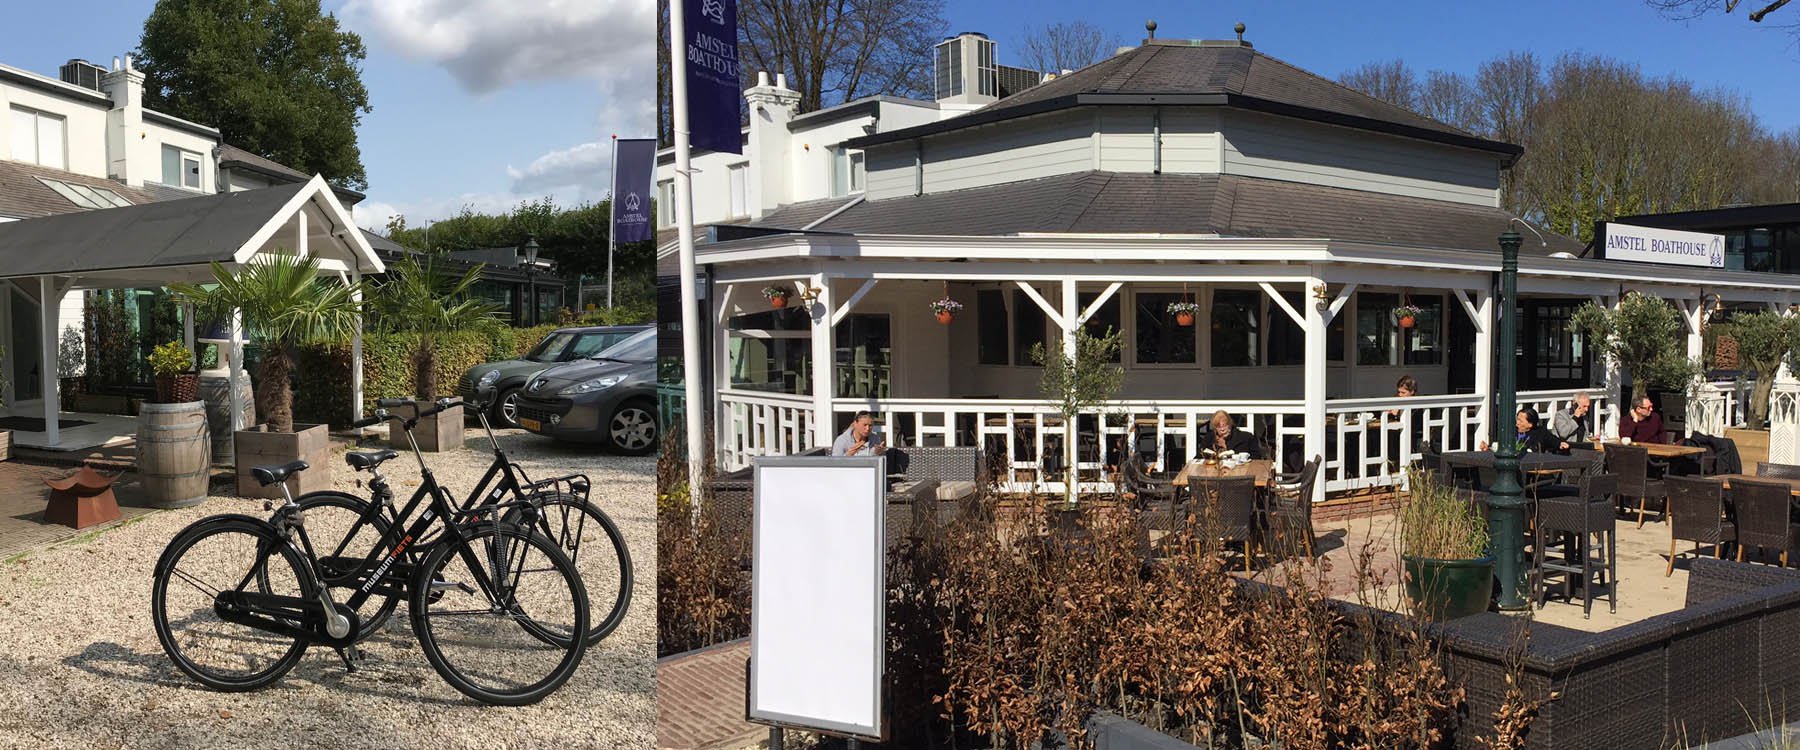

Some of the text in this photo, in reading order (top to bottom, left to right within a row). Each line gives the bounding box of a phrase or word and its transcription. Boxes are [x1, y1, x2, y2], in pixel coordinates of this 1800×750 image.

[696, 31, 737, 60] AMSEL
[1607, 234, 1706, 257] AMSTEL BOATHOUSE
